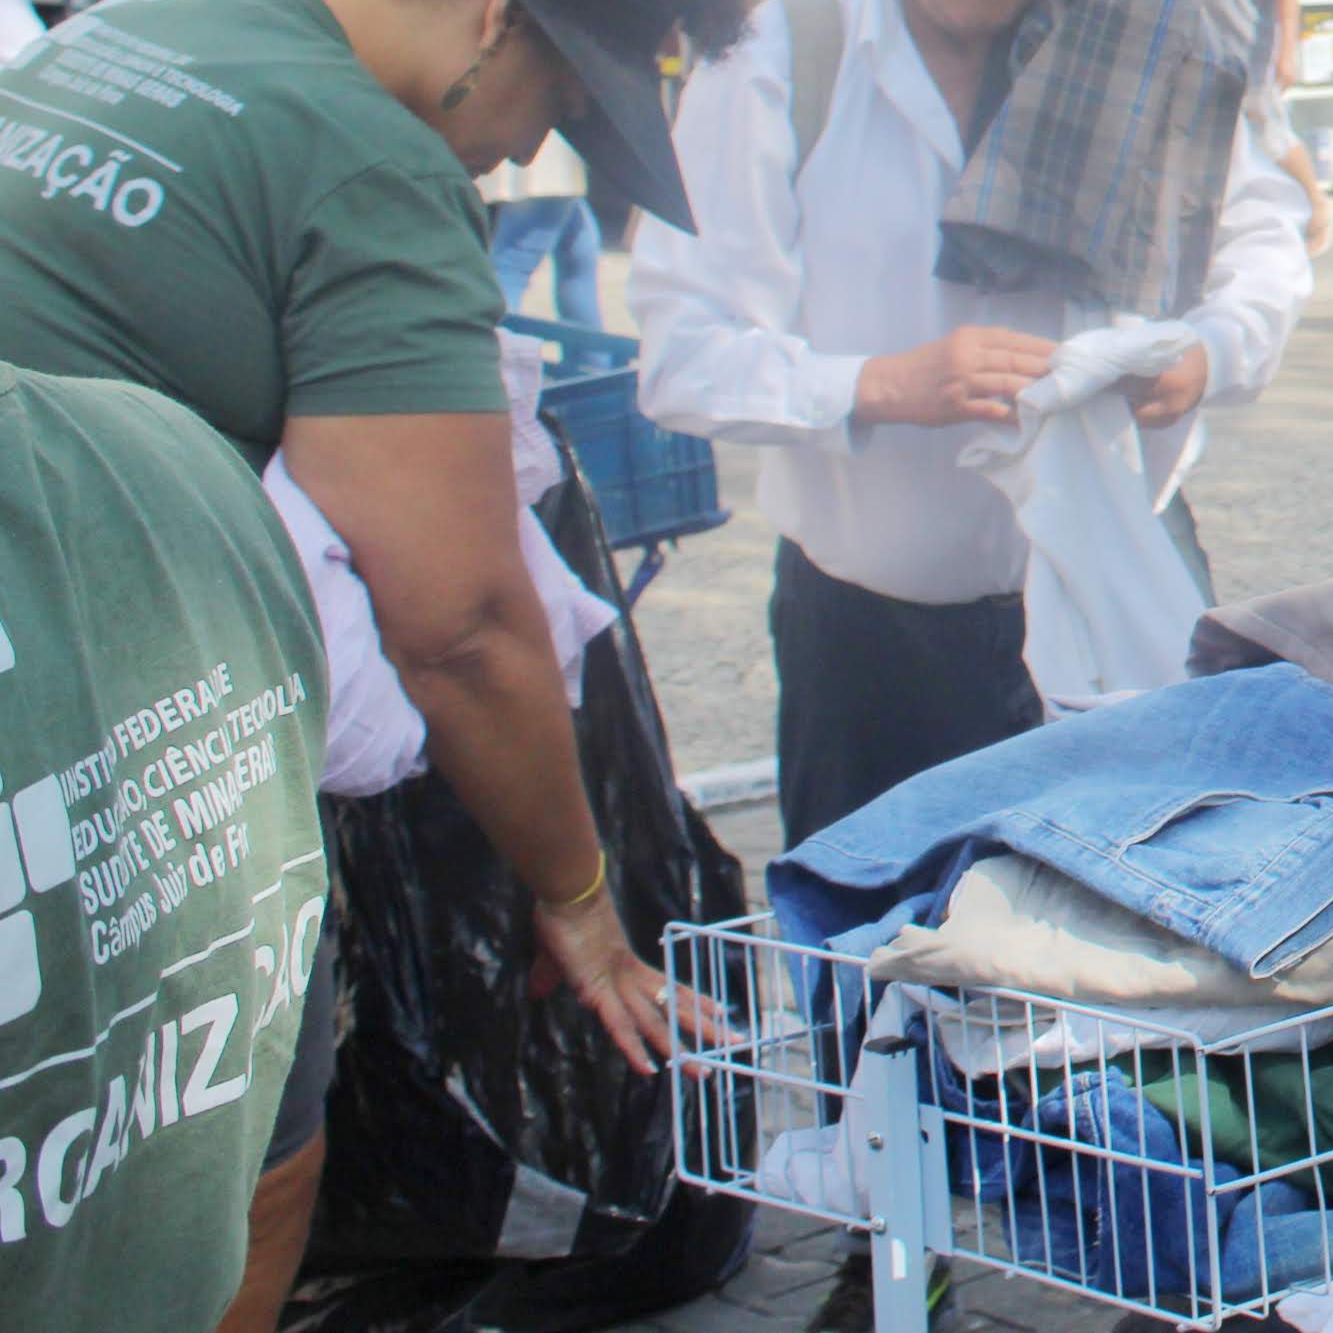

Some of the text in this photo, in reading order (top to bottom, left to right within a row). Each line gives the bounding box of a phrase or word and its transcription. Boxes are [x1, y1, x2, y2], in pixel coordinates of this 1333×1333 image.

[113, 670, 221, 759] FEDERA
[140, 809, 177, 860] DE
[173, 769, 244, 841] MINA
[188, 842, 226, 887] de
